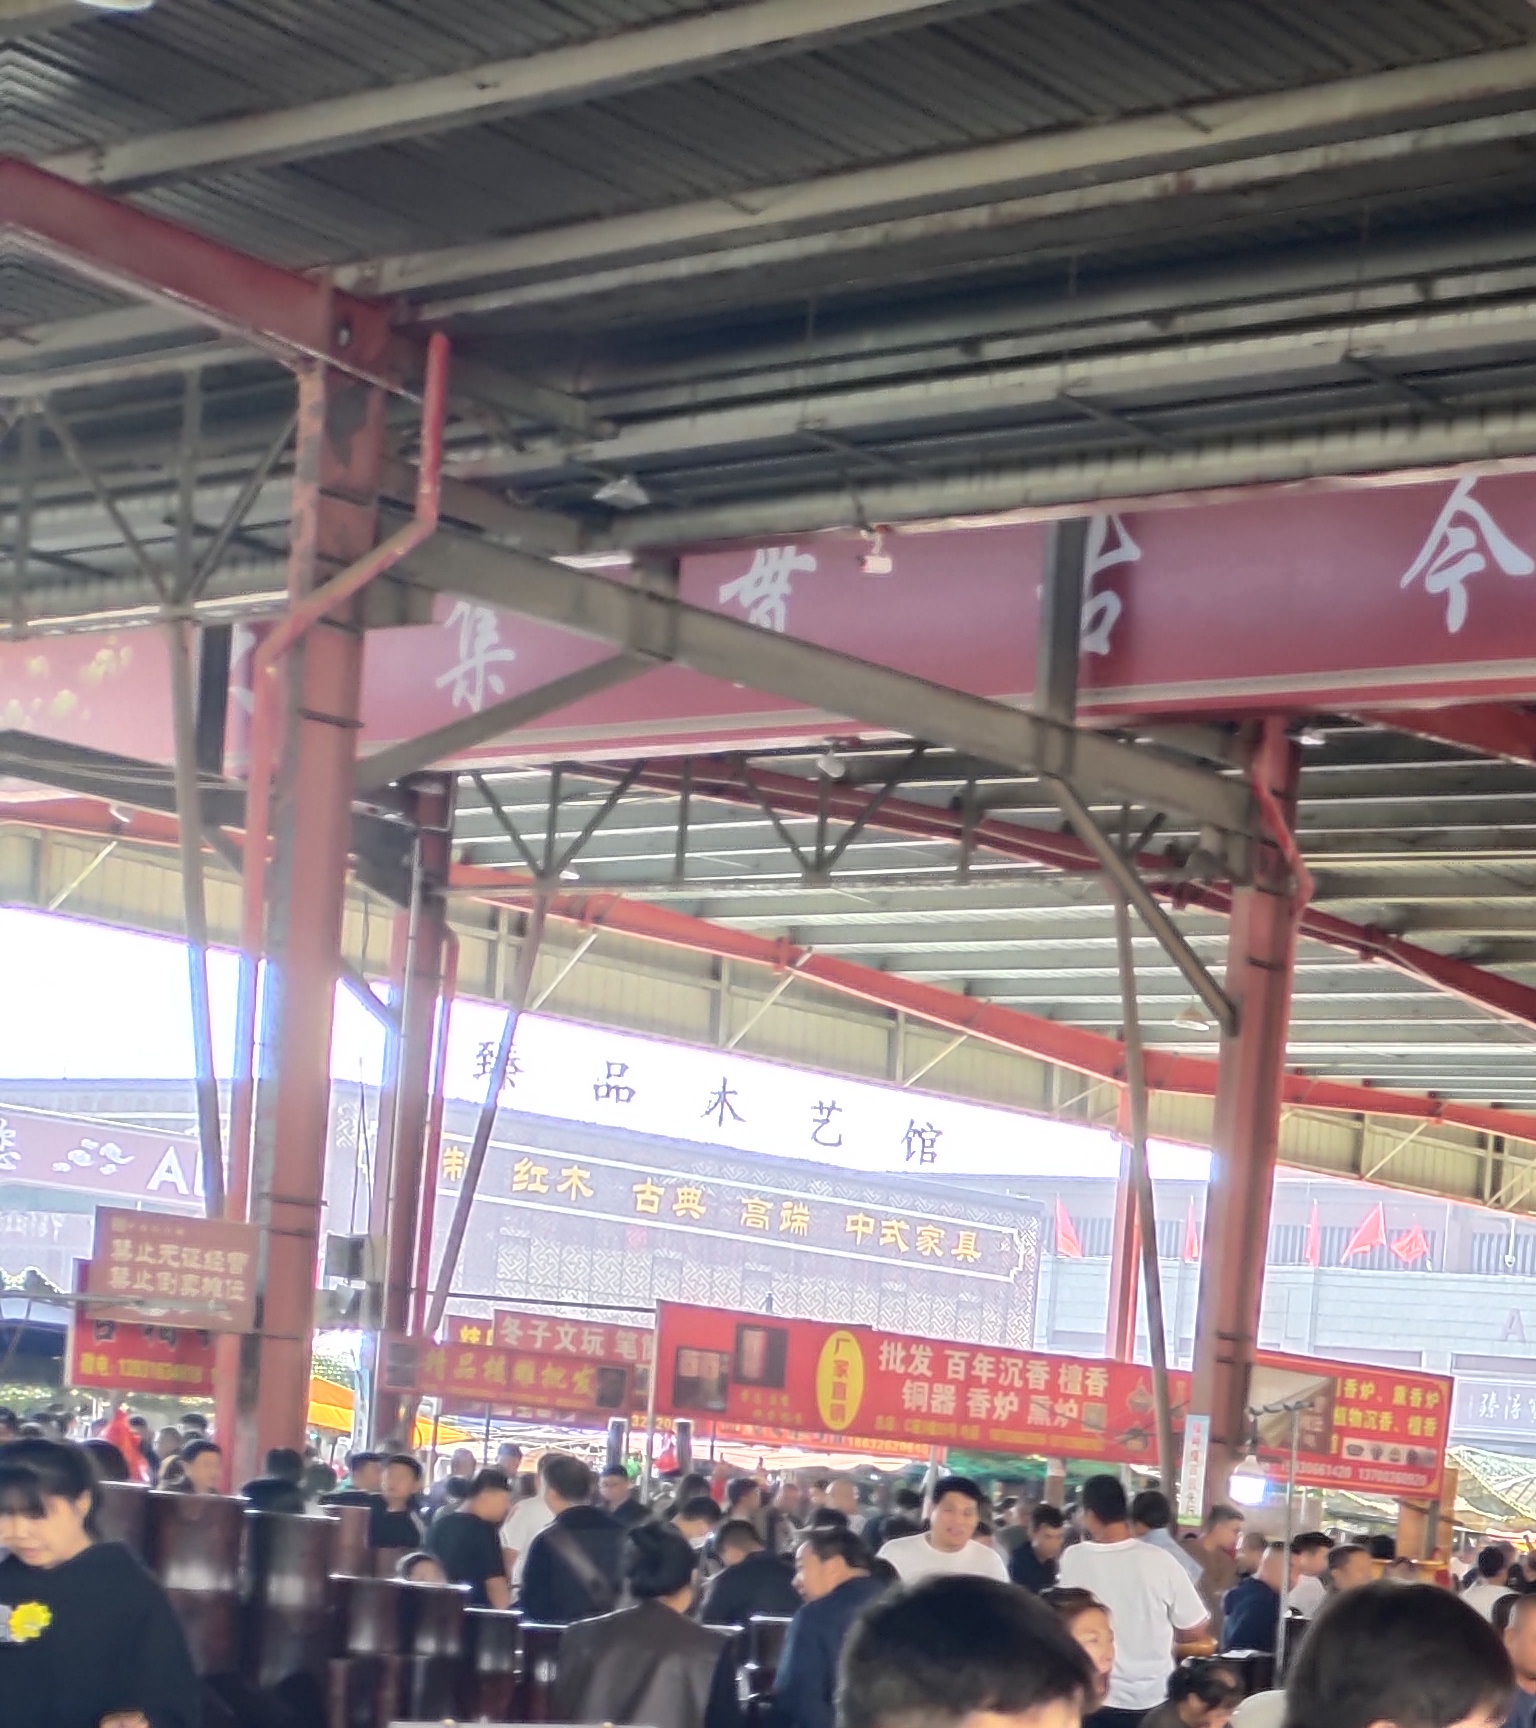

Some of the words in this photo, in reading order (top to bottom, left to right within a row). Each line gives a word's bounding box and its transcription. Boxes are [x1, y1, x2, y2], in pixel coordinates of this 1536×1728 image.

[511, 1155, 595, 1202] 红木
[632, 1181, 708, 1220] 古典
[740, 1196, 812, 1238] 高端
[844, 1211, 983, 1264] 中式家具
[502, 1314, 605, 1357] 冬子文玩
[878, 1339, 935, 1378] 批发
[943, 1349, 1049, 1391] 百年沉香
[1057, 1362, 1109, 1399] 檀香
[901, 1379, 957, 1416] 铜器
[966, 1387, 1019, 1422] 香炉
